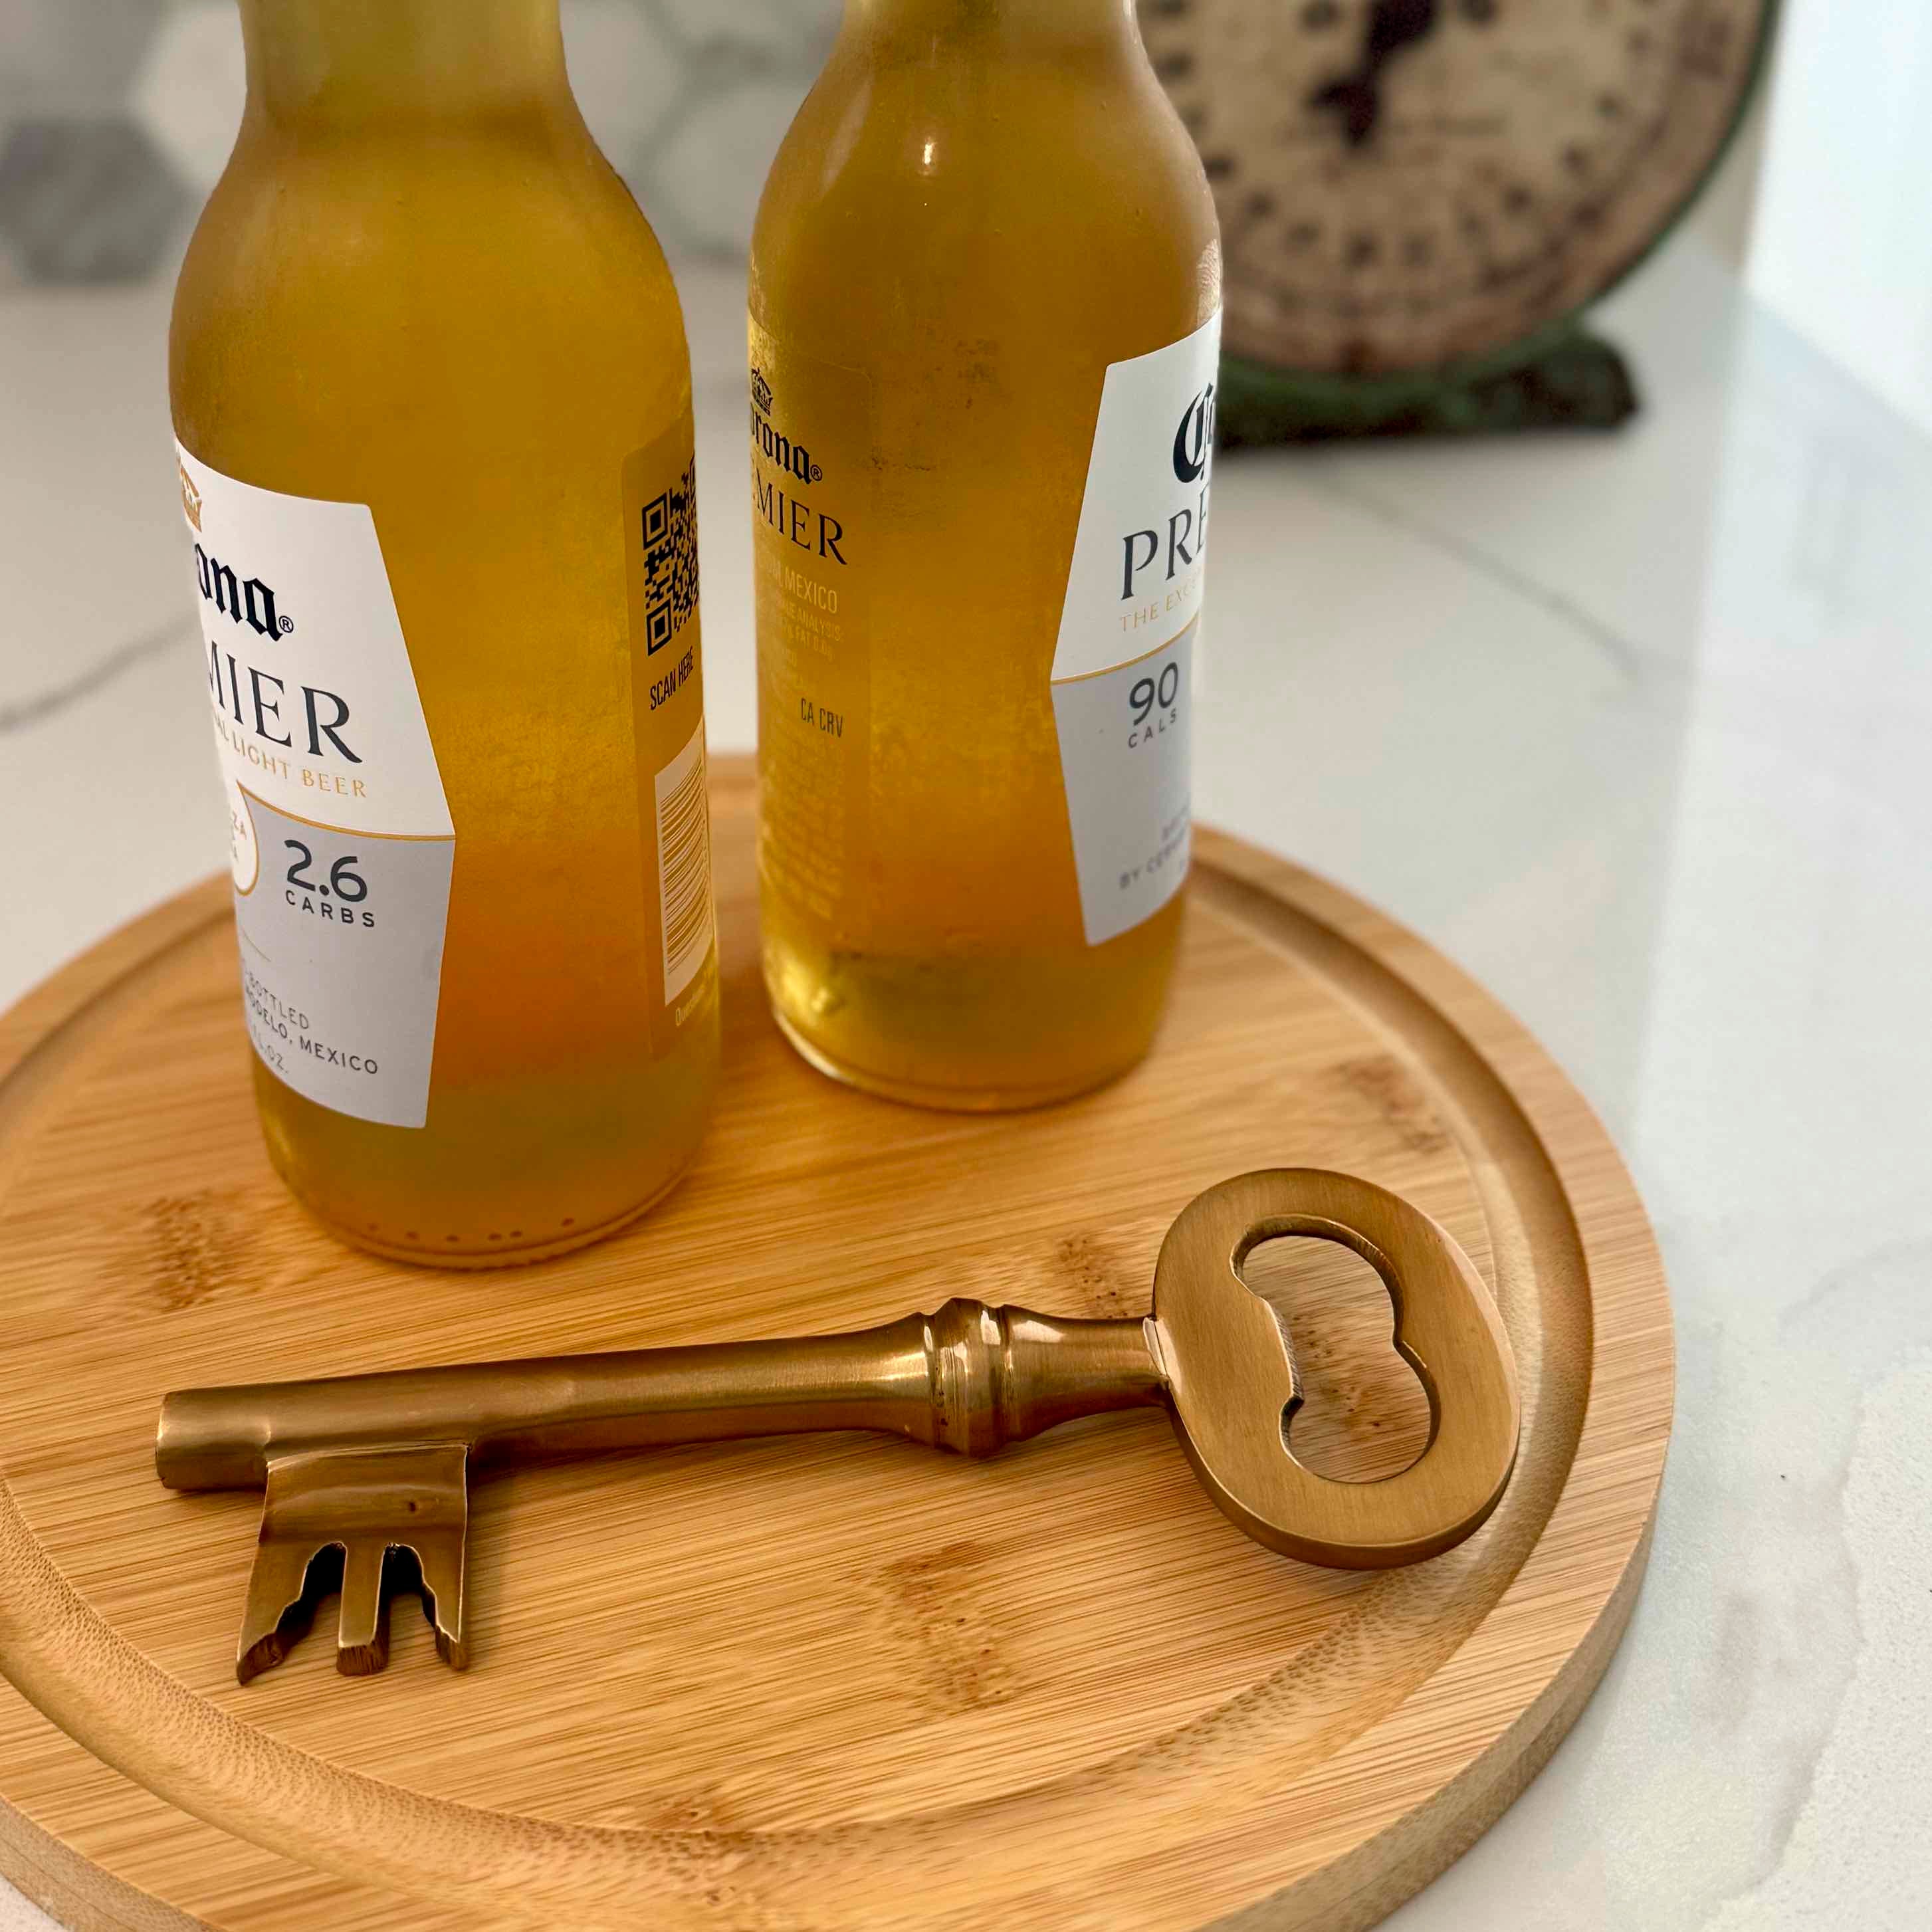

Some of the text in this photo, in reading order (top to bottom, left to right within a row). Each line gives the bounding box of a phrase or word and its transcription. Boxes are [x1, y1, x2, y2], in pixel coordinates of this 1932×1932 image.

[785, 567, 838, 614] MEXICO
[1120, 601, 1159, 632] THE
[650, 645, 693, 710] SCAN HERE
[1129, 661, 1179, 726] 90
[801, 698, 843, 738] CA CRV
[1128, 707, 1178, 748] CALS
[232, 730, 368, 799] LIGHT BEER
[284, 839, 368, 903] 2.6
[284, 889, 376, 927] CARBS
[300, 1035, 378, 1075] MEXICO
